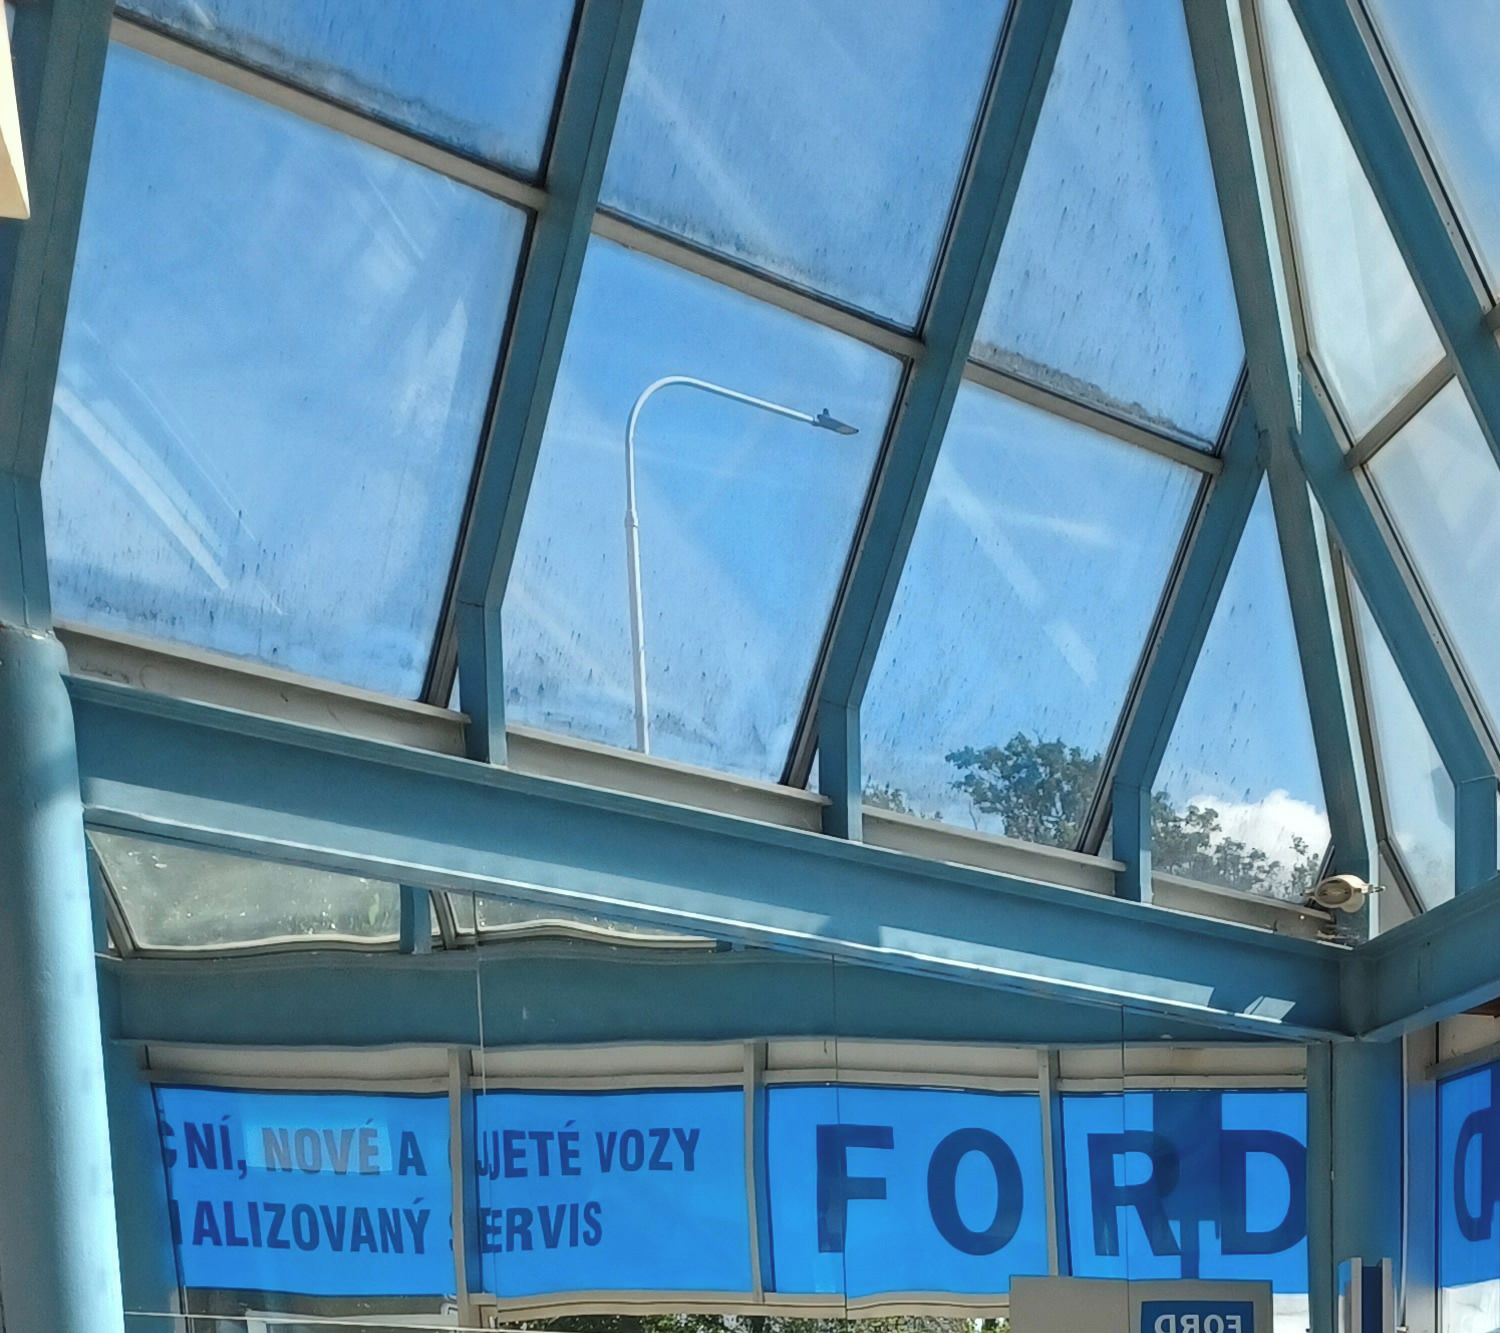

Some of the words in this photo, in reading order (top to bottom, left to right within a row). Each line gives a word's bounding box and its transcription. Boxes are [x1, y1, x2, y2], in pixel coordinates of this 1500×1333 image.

[261, 1118, 380, 1175] NOVÉ
[399, 1131, 428, 1176] A
[596, 1128, 700, 1173] VOZY
[816, 1124, 1307, 1256] FORD
